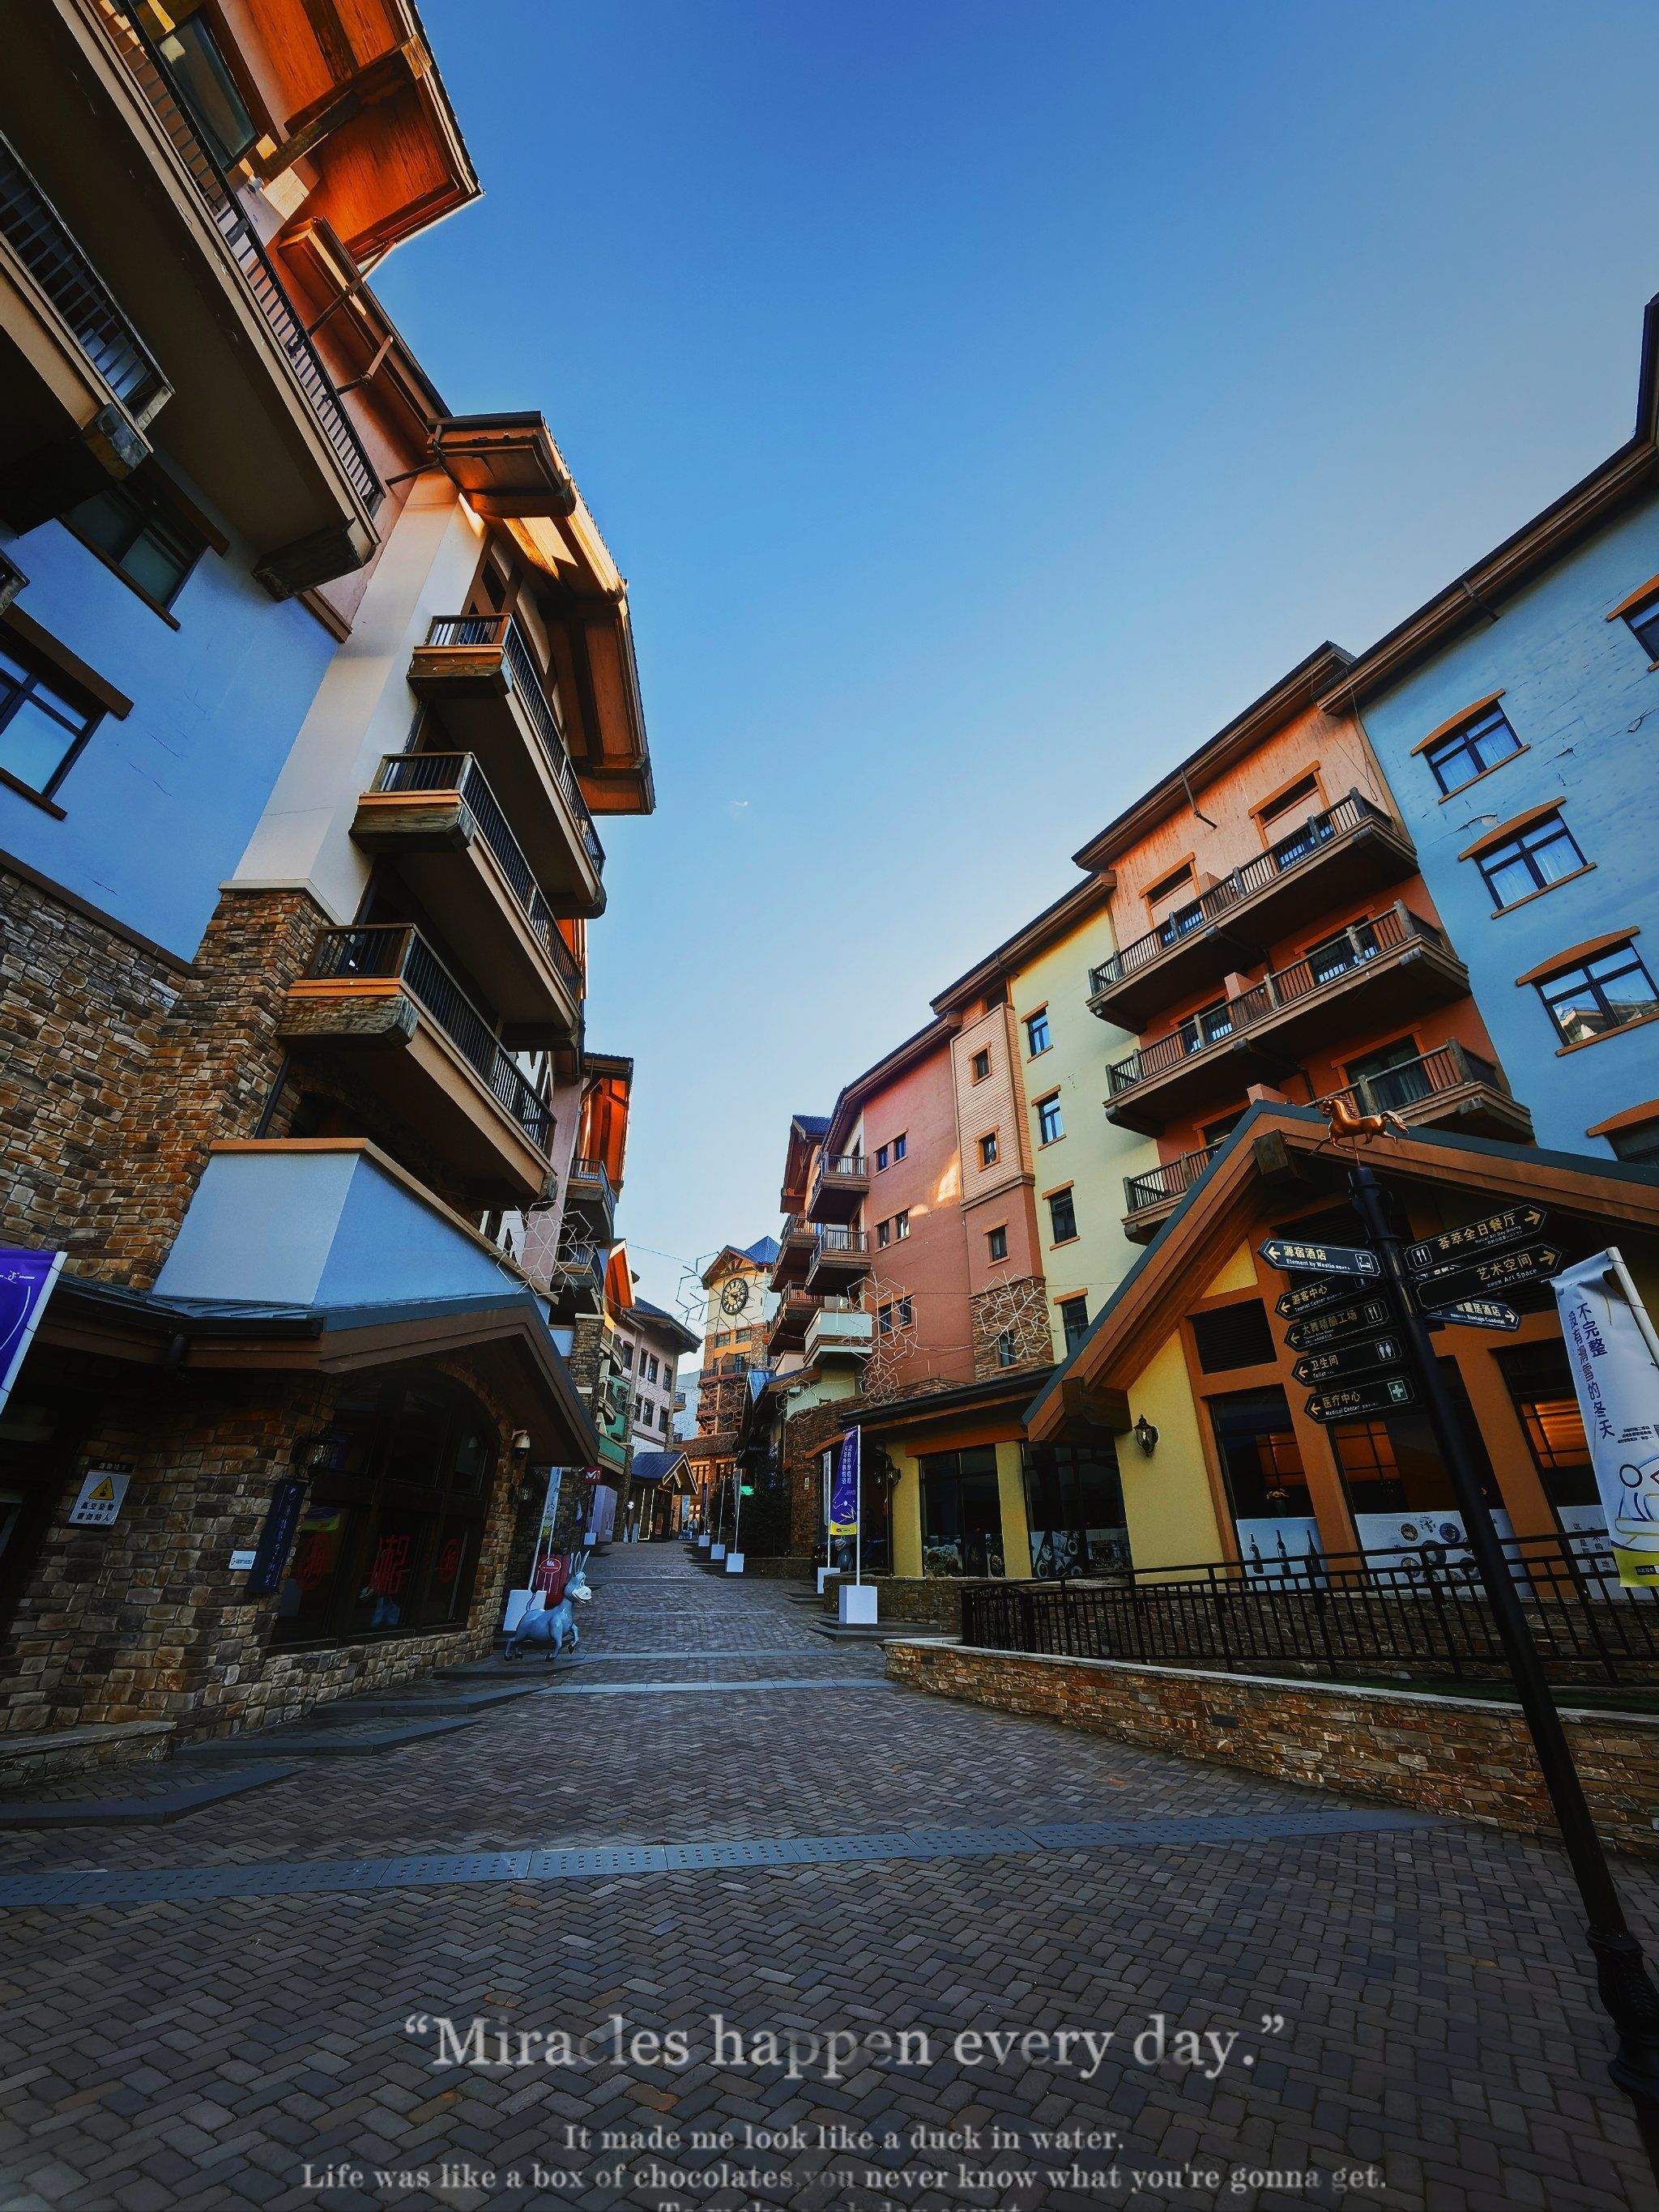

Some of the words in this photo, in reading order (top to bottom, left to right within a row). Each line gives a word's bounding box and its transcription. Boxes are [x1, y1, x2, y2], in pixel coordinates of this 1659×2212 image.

[1437, 1213, 1515, 1250] 荟萃全日餐厅
[1283, 1245, 1327, 1261] 源宿酒店
[1286, 1258, 1309, 1268] Element
[1309, 1260, 1316, 1268] by
[1476, 1253, 1533, 1281] 艺术空间
[1504, 1275, 1516, 1283] Art
[1516, 1268, 1537, 1279] Space
[1291, 1285, 1328, 1306] 游客中心
[1310, 1298, 1325, 1307] Center
[1577, 1302, 1608, 1357] 不完整
[1311, 1354, 1339, 1371] 卫生间
[1322, 1391, 1361, 1409] 医疗中心
[1325, 1408, 1344, 1416] Medical
[1343, 1404, 1360, 1413] Center
